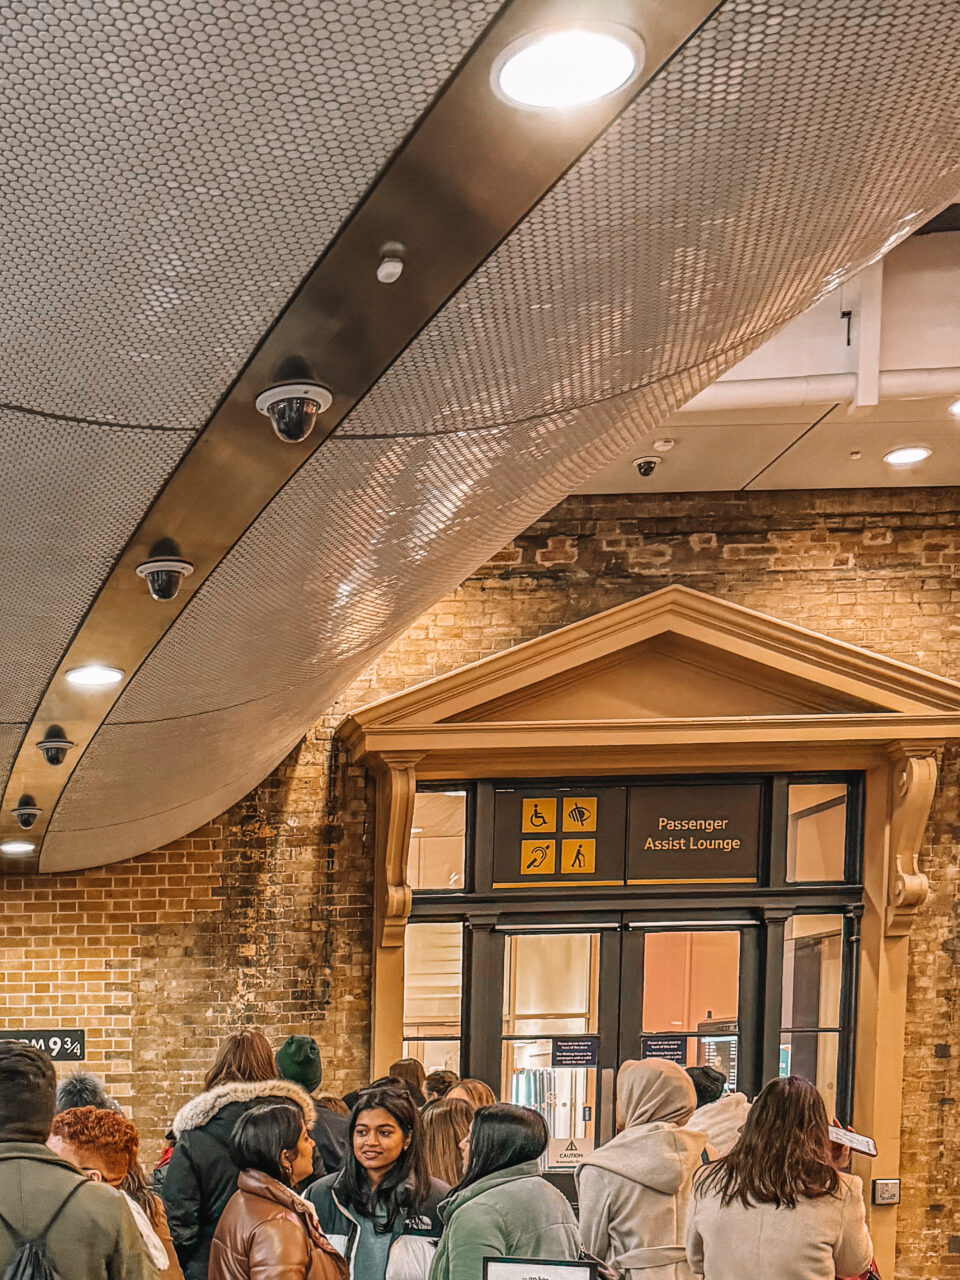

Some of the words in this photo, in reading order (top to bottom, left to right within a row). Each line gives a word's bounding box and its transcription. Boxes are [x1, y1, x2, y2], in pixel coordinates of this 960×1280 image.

[658, 817, 728, 832] Passenger
[643, 837, 686, 850] Assist
[689, 837, 740, 852] Lounge
